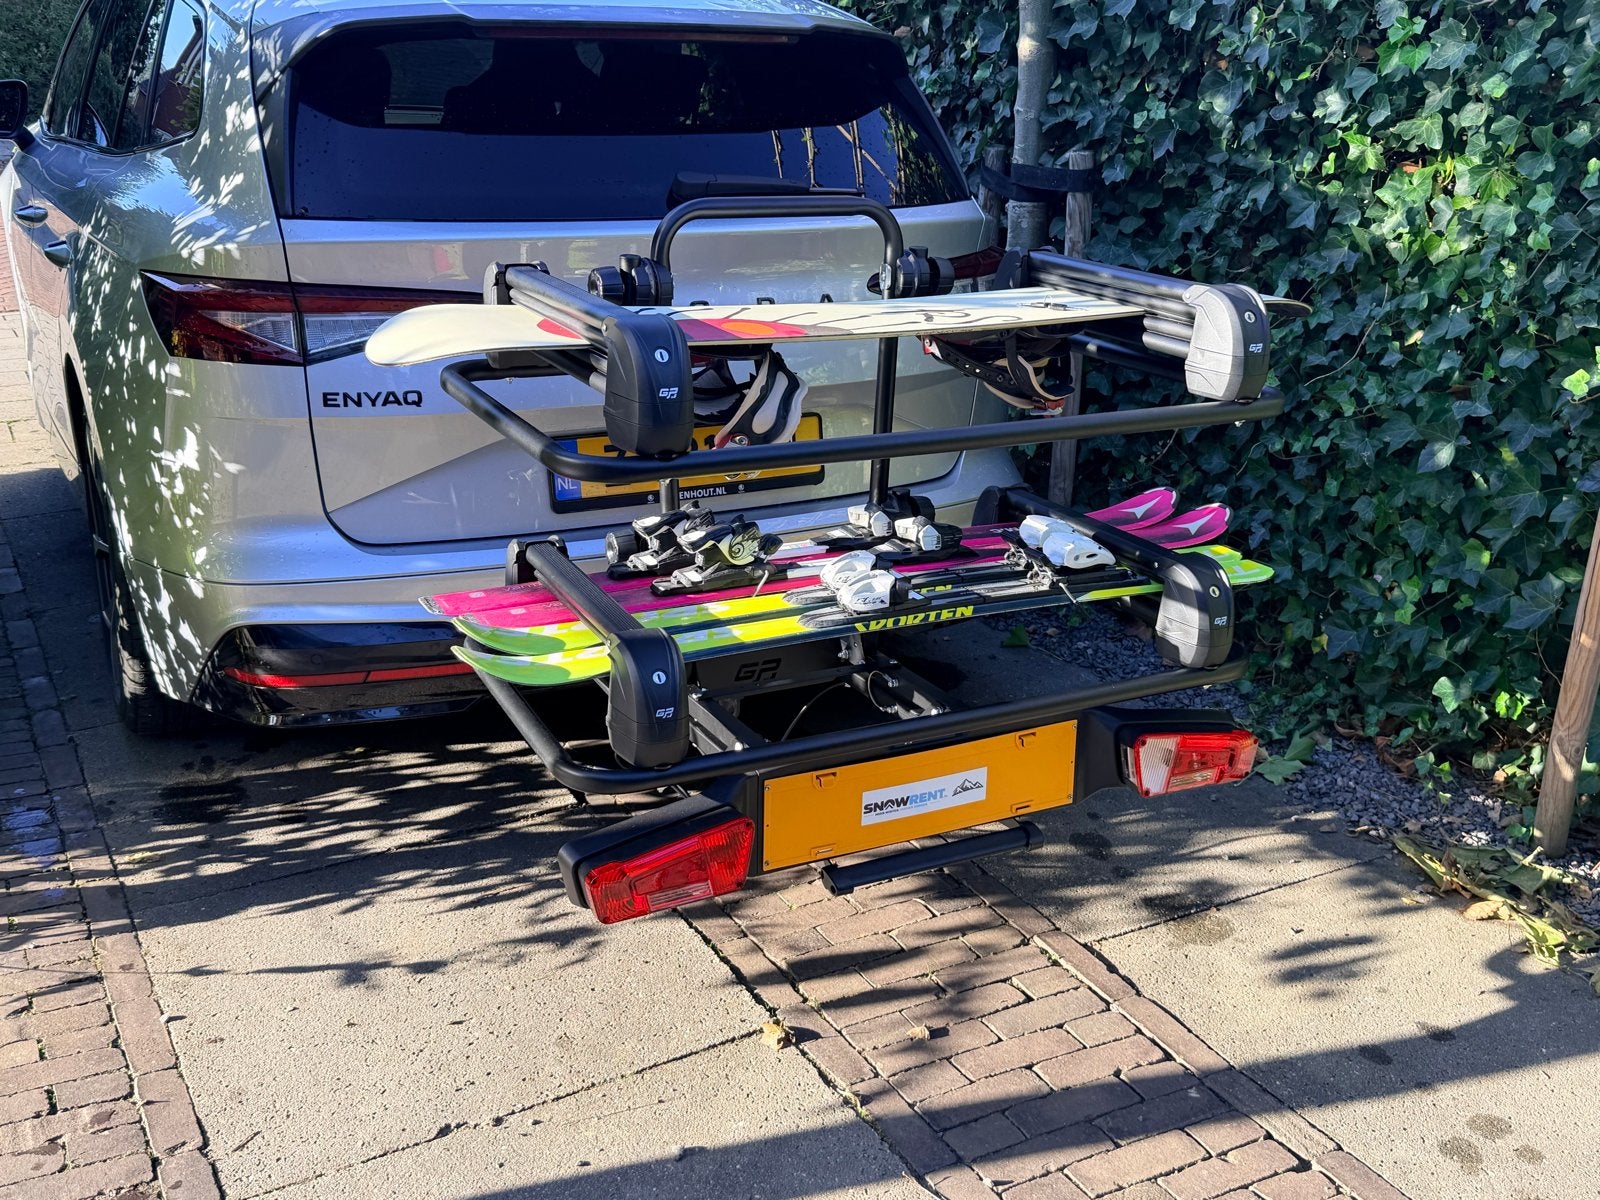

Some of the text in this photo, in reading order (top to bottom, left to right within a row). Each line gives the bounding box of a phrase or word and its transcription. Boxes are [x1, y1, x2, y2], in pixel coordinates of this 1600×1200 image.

[322, 390, 423, 408] ENYAQ
[557, 477, 577, 491] NL
[679, 486, 728, 500] ENHOUT.NL
[863, 788, 946, 815] SNOWRENT
